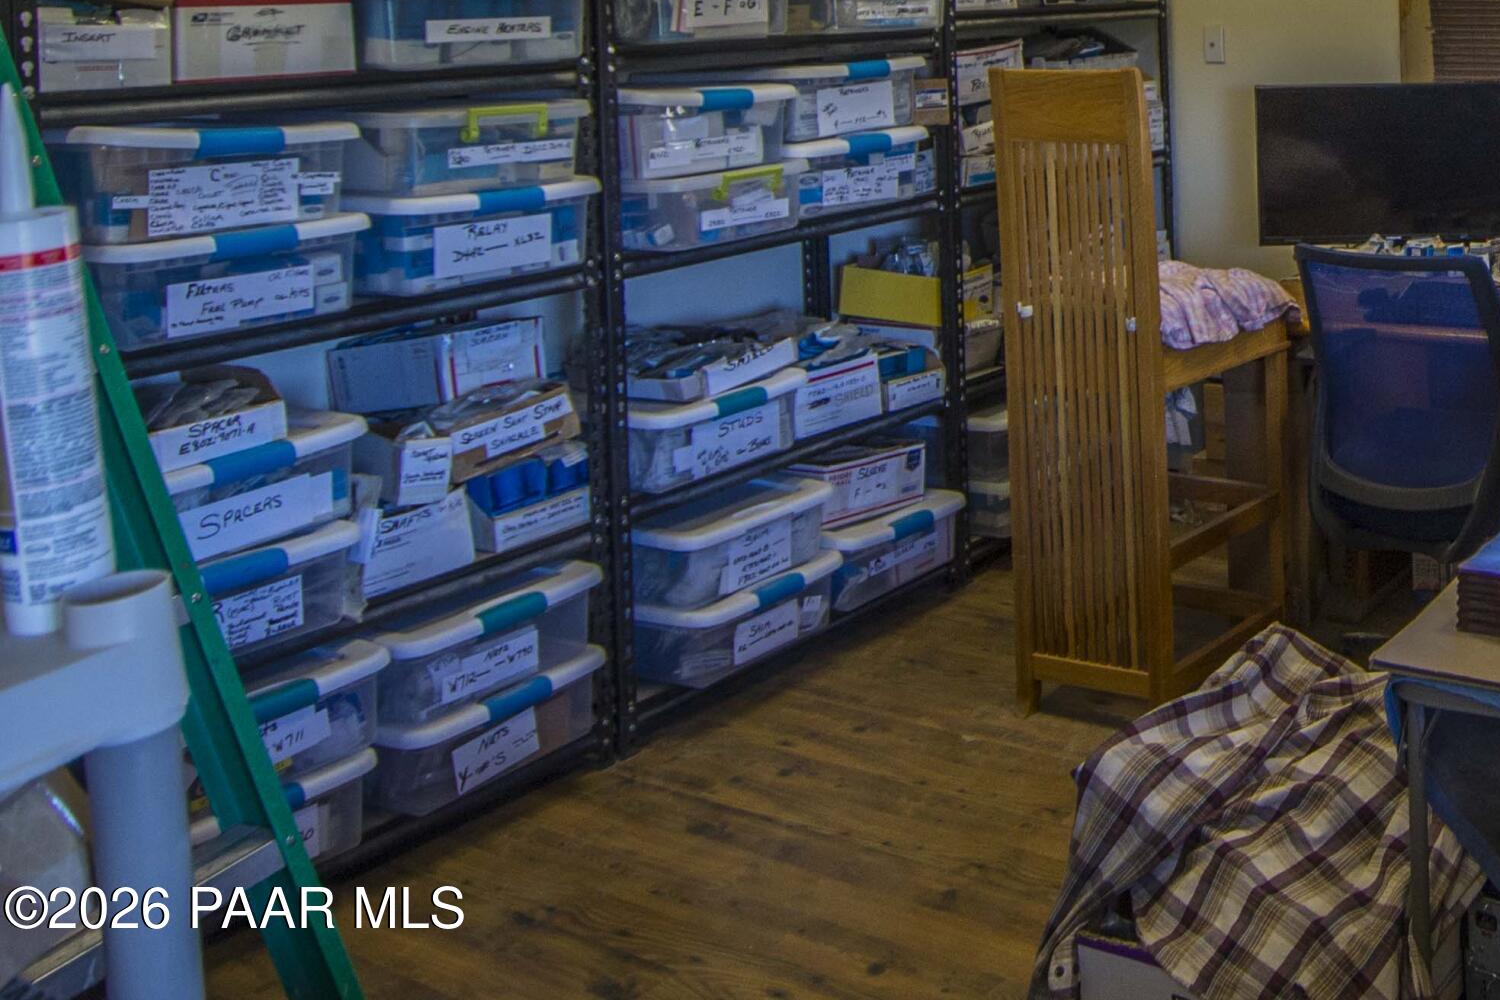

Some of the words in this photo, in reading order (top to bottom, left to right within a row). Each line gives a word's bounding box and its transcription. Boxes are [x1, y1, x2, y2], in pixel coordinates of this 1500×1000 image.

[188, 415, 241, 438] SPACER
[718, 410, 763, 438] STUDS
[197, 494, 283, 540] SPACERS
